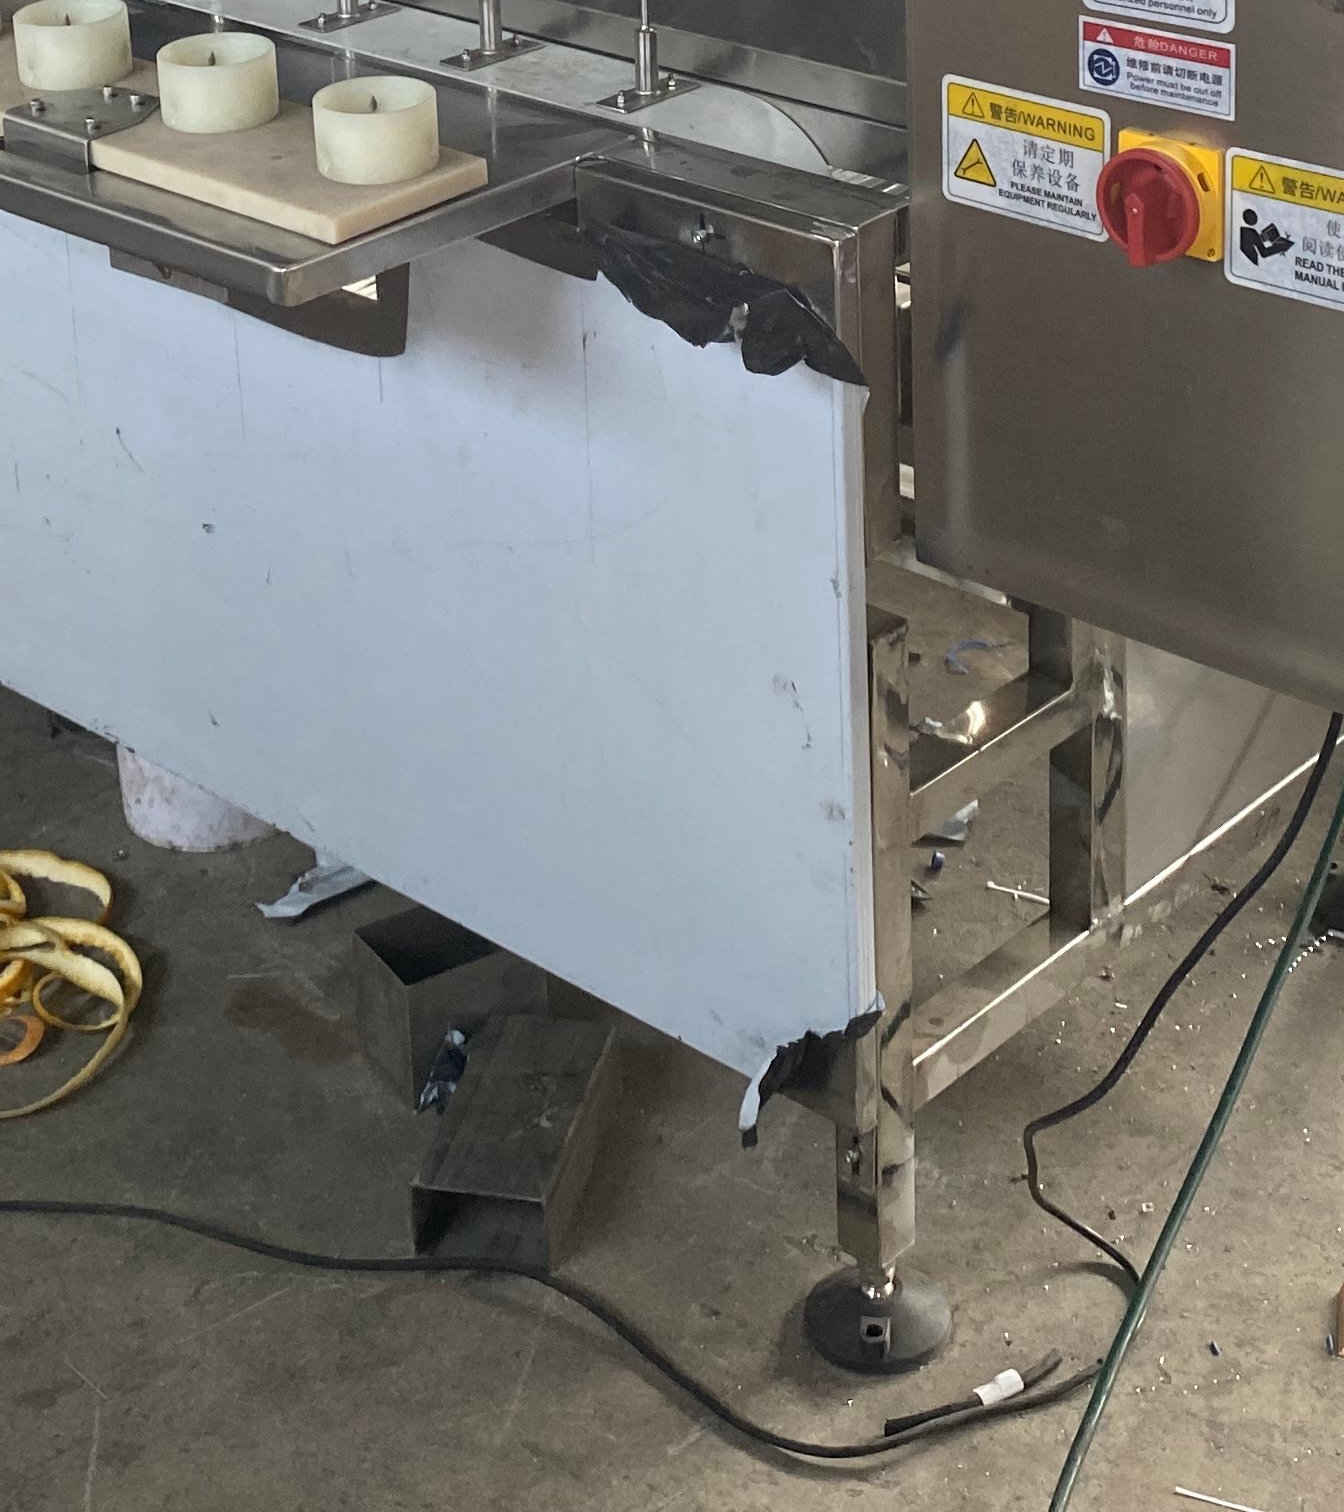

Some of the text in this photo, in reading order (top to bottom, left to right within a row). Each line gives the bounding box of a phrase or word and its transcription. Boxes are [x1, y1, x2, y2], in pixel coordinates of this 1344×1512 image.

[1148, 0, 1195, 14] personnel
[1197, 8, 1218, 19] only
[1127, 56, 1223, 86] 维修前请切断电源
[1127, 71, 1154, 84] Power
[1156, 79, 1178, 88] must
[1180, 82, 1191, 91] be
[1210, 89, 1222, 98] off
[1130, 82, 1218, 107] before maintenance
[989, 102, 1095, 141] 警告/WARNING
[1023, 139, 1074, 169] 请定期
[1012, 158, 1080, 192] 保养设备
[998, 188, 1096, 221] EQUIPMENT REGULARLY
[1010, 180, 1083, 207] PLEASE MAINTAIN
[1294, 256, 1324, 272] READ
[1294, 270, 1339, 291] MANUAL
